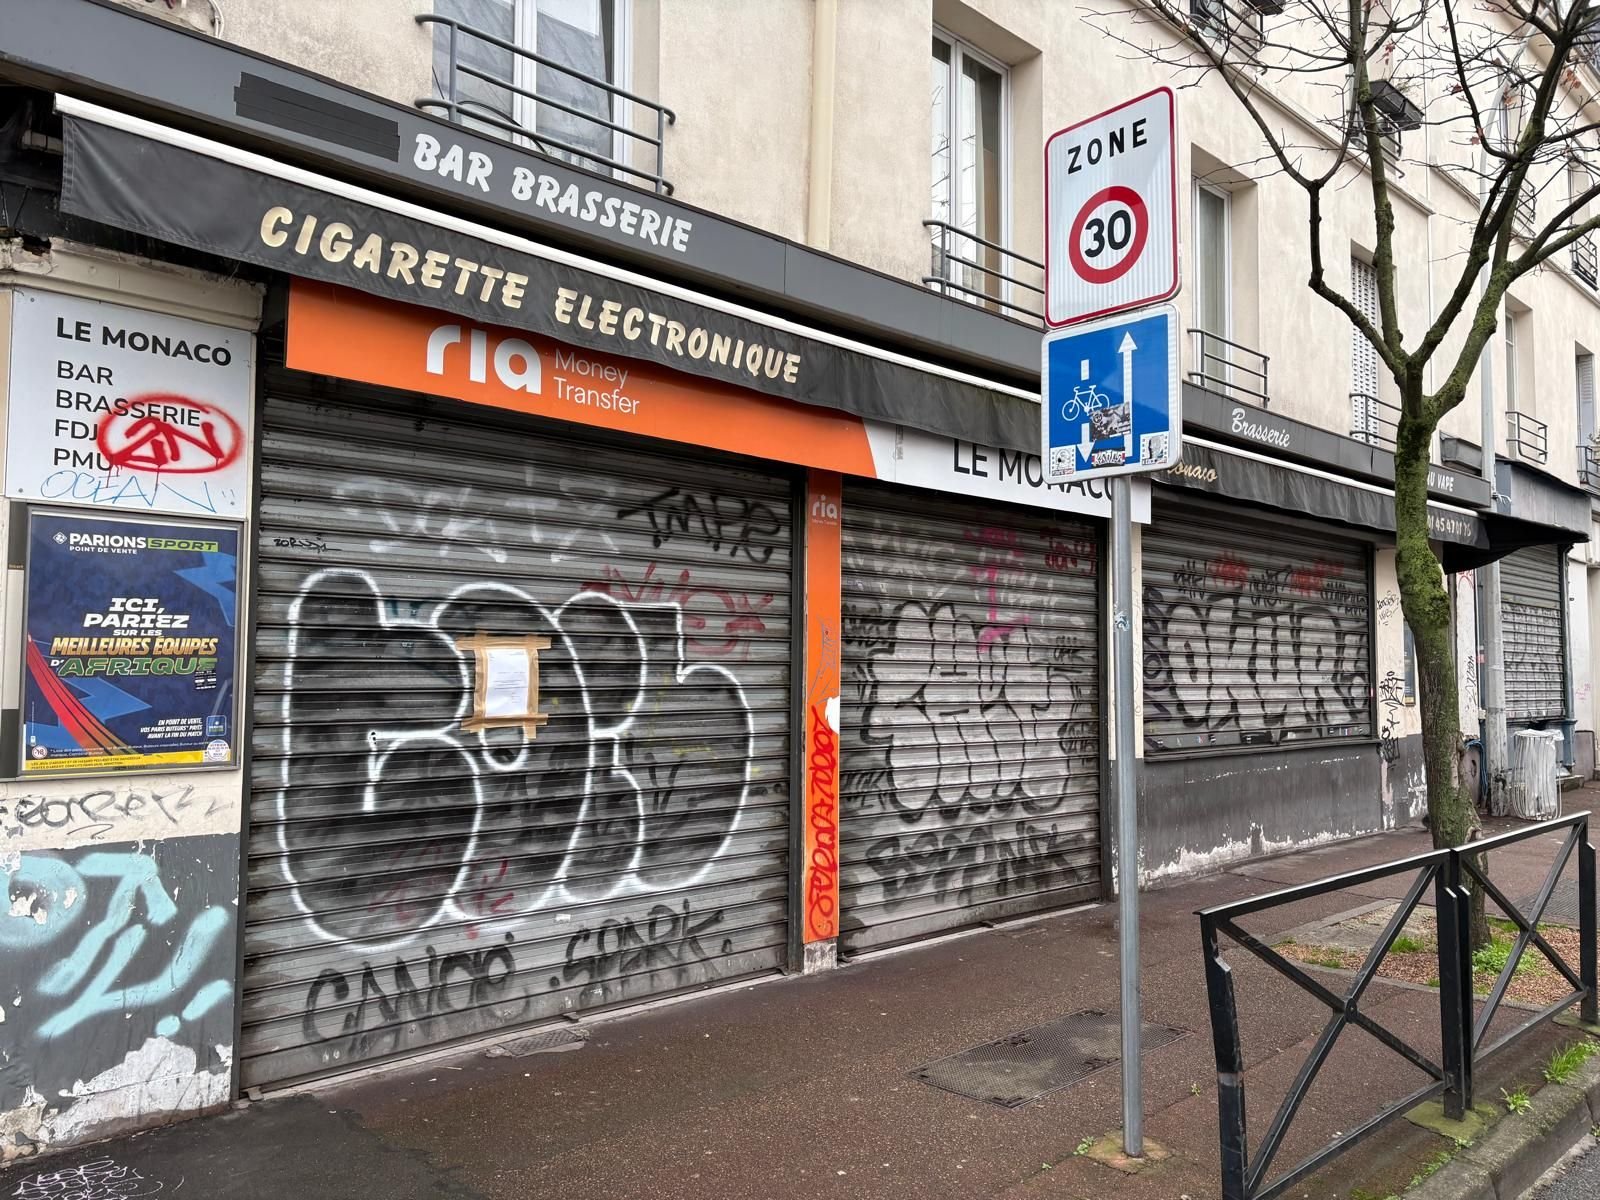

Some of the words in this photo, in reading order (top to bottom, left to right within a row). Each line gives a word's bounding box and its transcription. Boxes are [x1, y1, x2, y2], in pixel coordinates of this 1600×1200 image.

[1067, 117, 1148, 175] ZONE
[413, 132, 494, 193] BAR
[511, 165, 693, 253] BRASSERIE
[1084, 209, 1132, 258] 30
[260, 206, 529, 309] CIGARETTE
[554, 286, 801, 384] ELECTRONIQUE
[56, 316, 92, 343] LE
[101, 325, 232, 367] MONACO
[426, 324, 542, 395] ria
[555, 348, 628, 389] Money
[57, 360, 114, 386] BAR
[55, 388, 201, 427] BRASSERIE
[553, 376, 640, 415] Transfer
[54, 418, 98, 441] FDJ
[1231, 407, 1291, 447] Brasserie
[53, 447, 114, 472] PMU
[953, 438, 988, 478] LE
[1168, 461, 1218, 482] onaco
[1437, 473, 1454, 492] VAPE
[812, 494, 838, 520] ria
[1435, 517, 1445, 532] 45
[69, 532, 147, 549] PARIONS
[149, 538, 216, 551] SPORT
[109, 597, 165, 614] ICI,
[83, 613, 190, 629] PARIEZ
[113, 629, 138, 637] SUR
[140, 629, 163, 637] LES
[50, 637, 151, 656] MEILLEURES
[152, 634, 219, 656] ÉQUIPES
